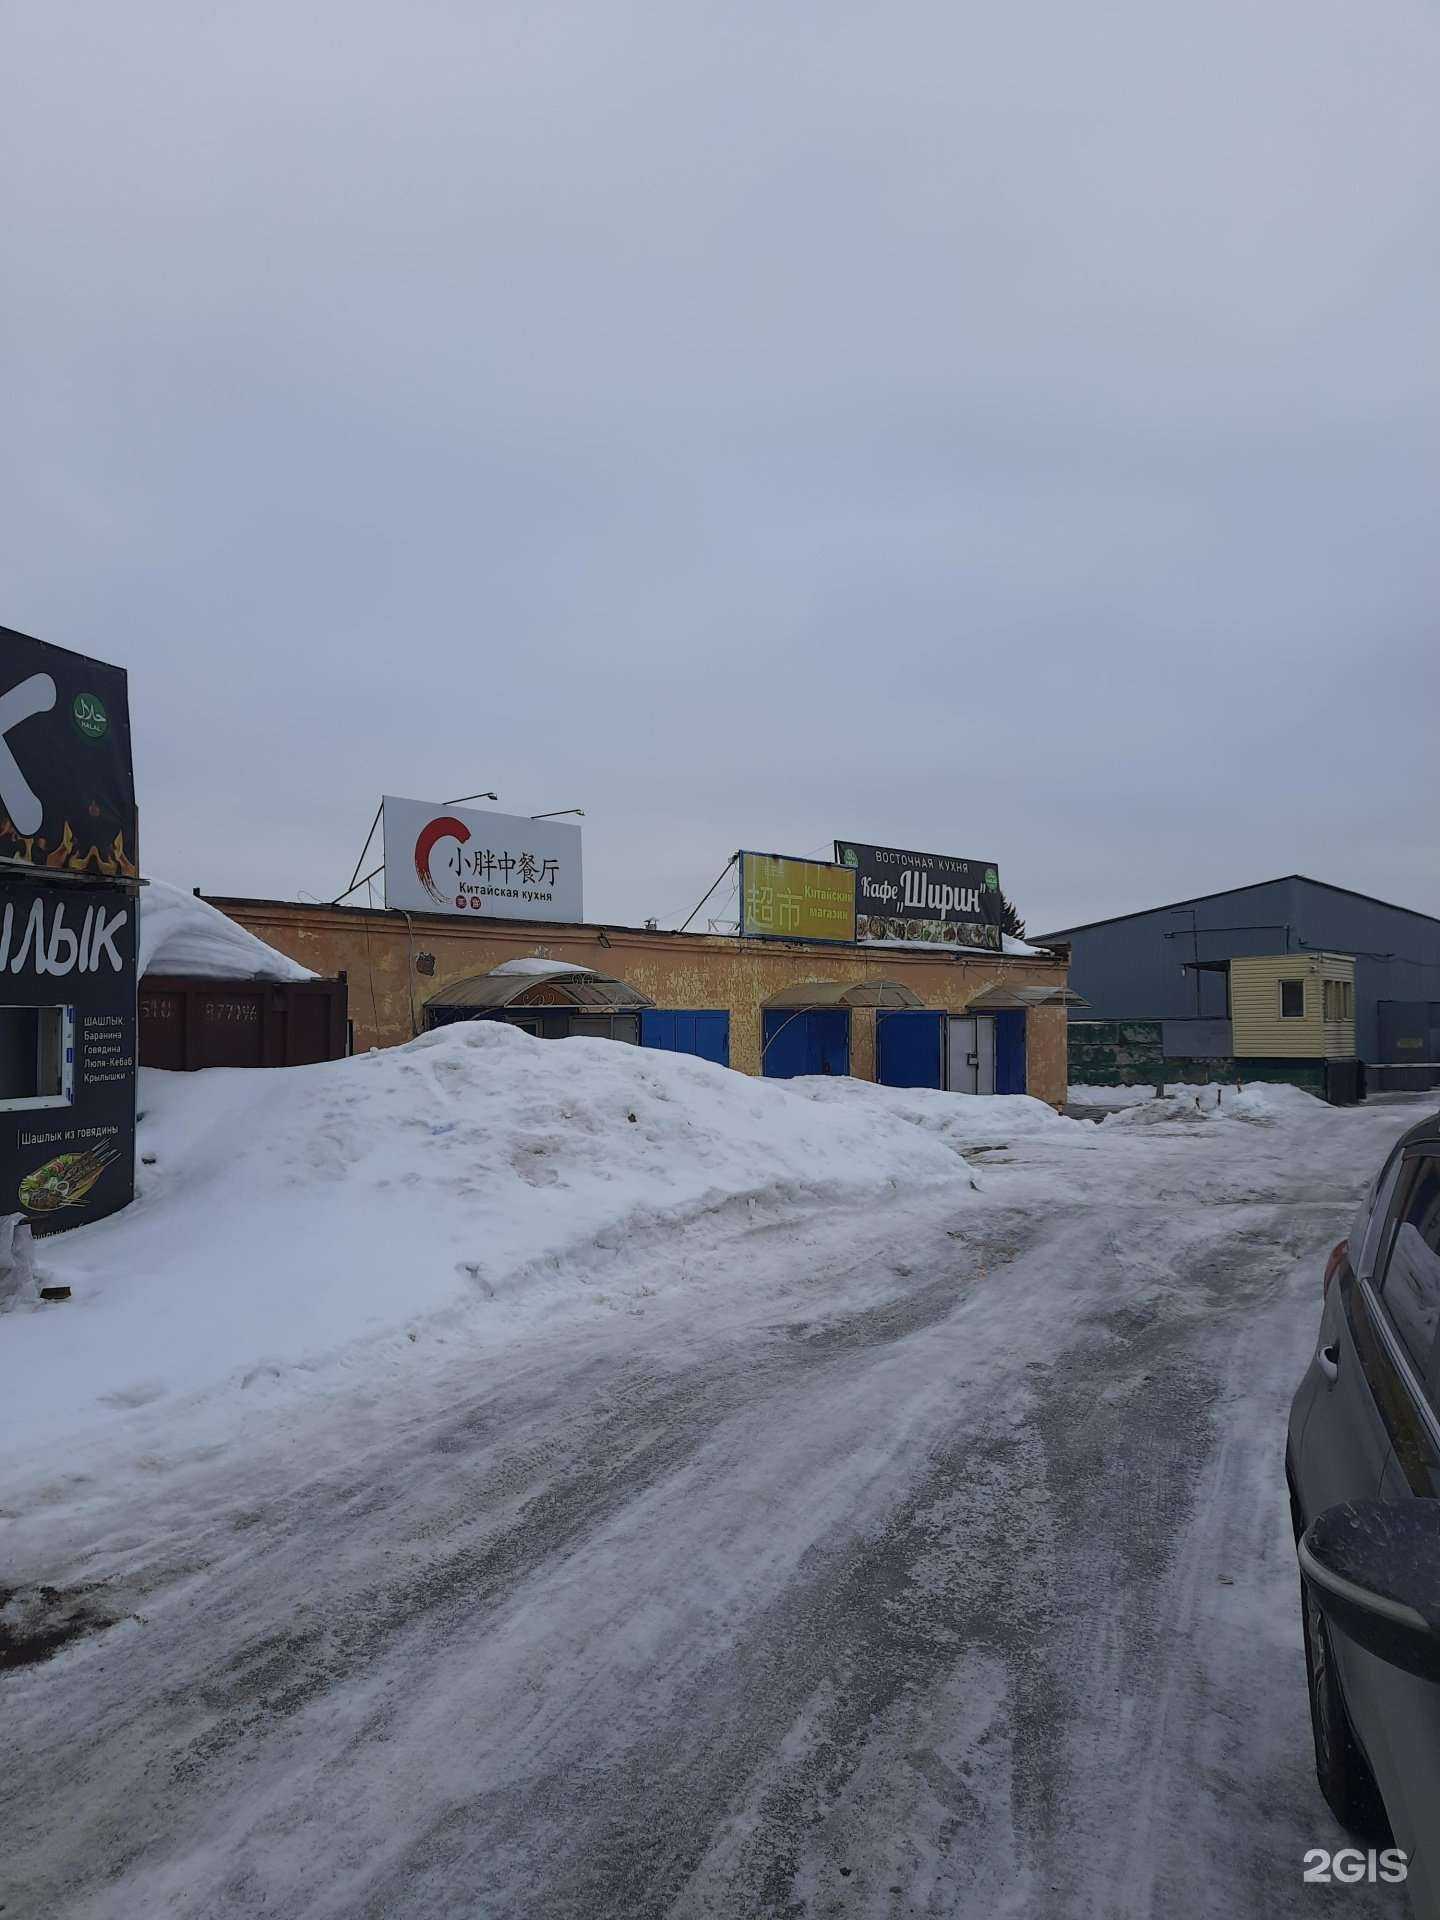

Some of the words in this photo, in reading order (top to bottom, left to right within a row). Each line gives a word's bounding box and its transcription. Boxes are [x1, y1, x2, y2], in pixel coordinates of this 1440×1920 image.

[448, 847, 560, 887] 小胖中餐厅
[876, 851, 934, 869] ВОСТОЧНАЯ
[938, 860, 969, 874] КУХНЯ
[459, 882, 519, 898] Китайская
[522, 890, 553, 903] кухня
[861, 876, 899, 904] Кафе
[84, 1015, 124, 1027] ШАШЛЫК
[84, 1030, 122, 1042] Баранина
[84, 1044, 121, 1055] Говядина
[84, 1072, 126, 1084] Крылышки
[21, 1131, 62, 1145] Шашлык
[64, 1130, 75, 1140] из
[77, 1125, 119, 1138] говядины
